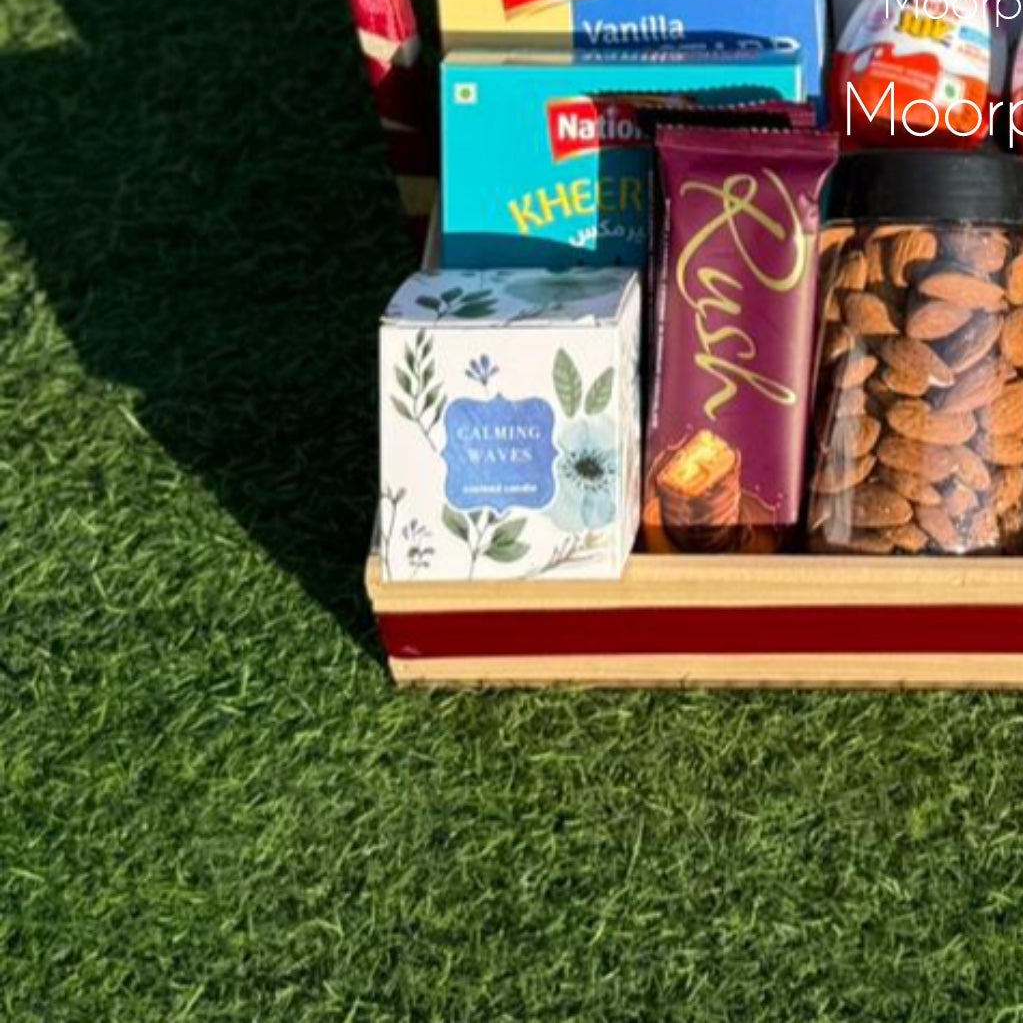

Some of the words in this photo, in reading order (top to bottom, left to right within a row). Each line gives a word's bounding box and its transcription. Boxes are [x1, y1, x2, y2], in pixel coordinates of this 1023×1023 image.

[582, 13, 686, 45] Vanilla
[507, 177, 644, 237] KHEER
[676, 168, 807, 419] Rush
[456, 425, 541, 441] CALMING
[466, 447, 533, 464] WAVES
